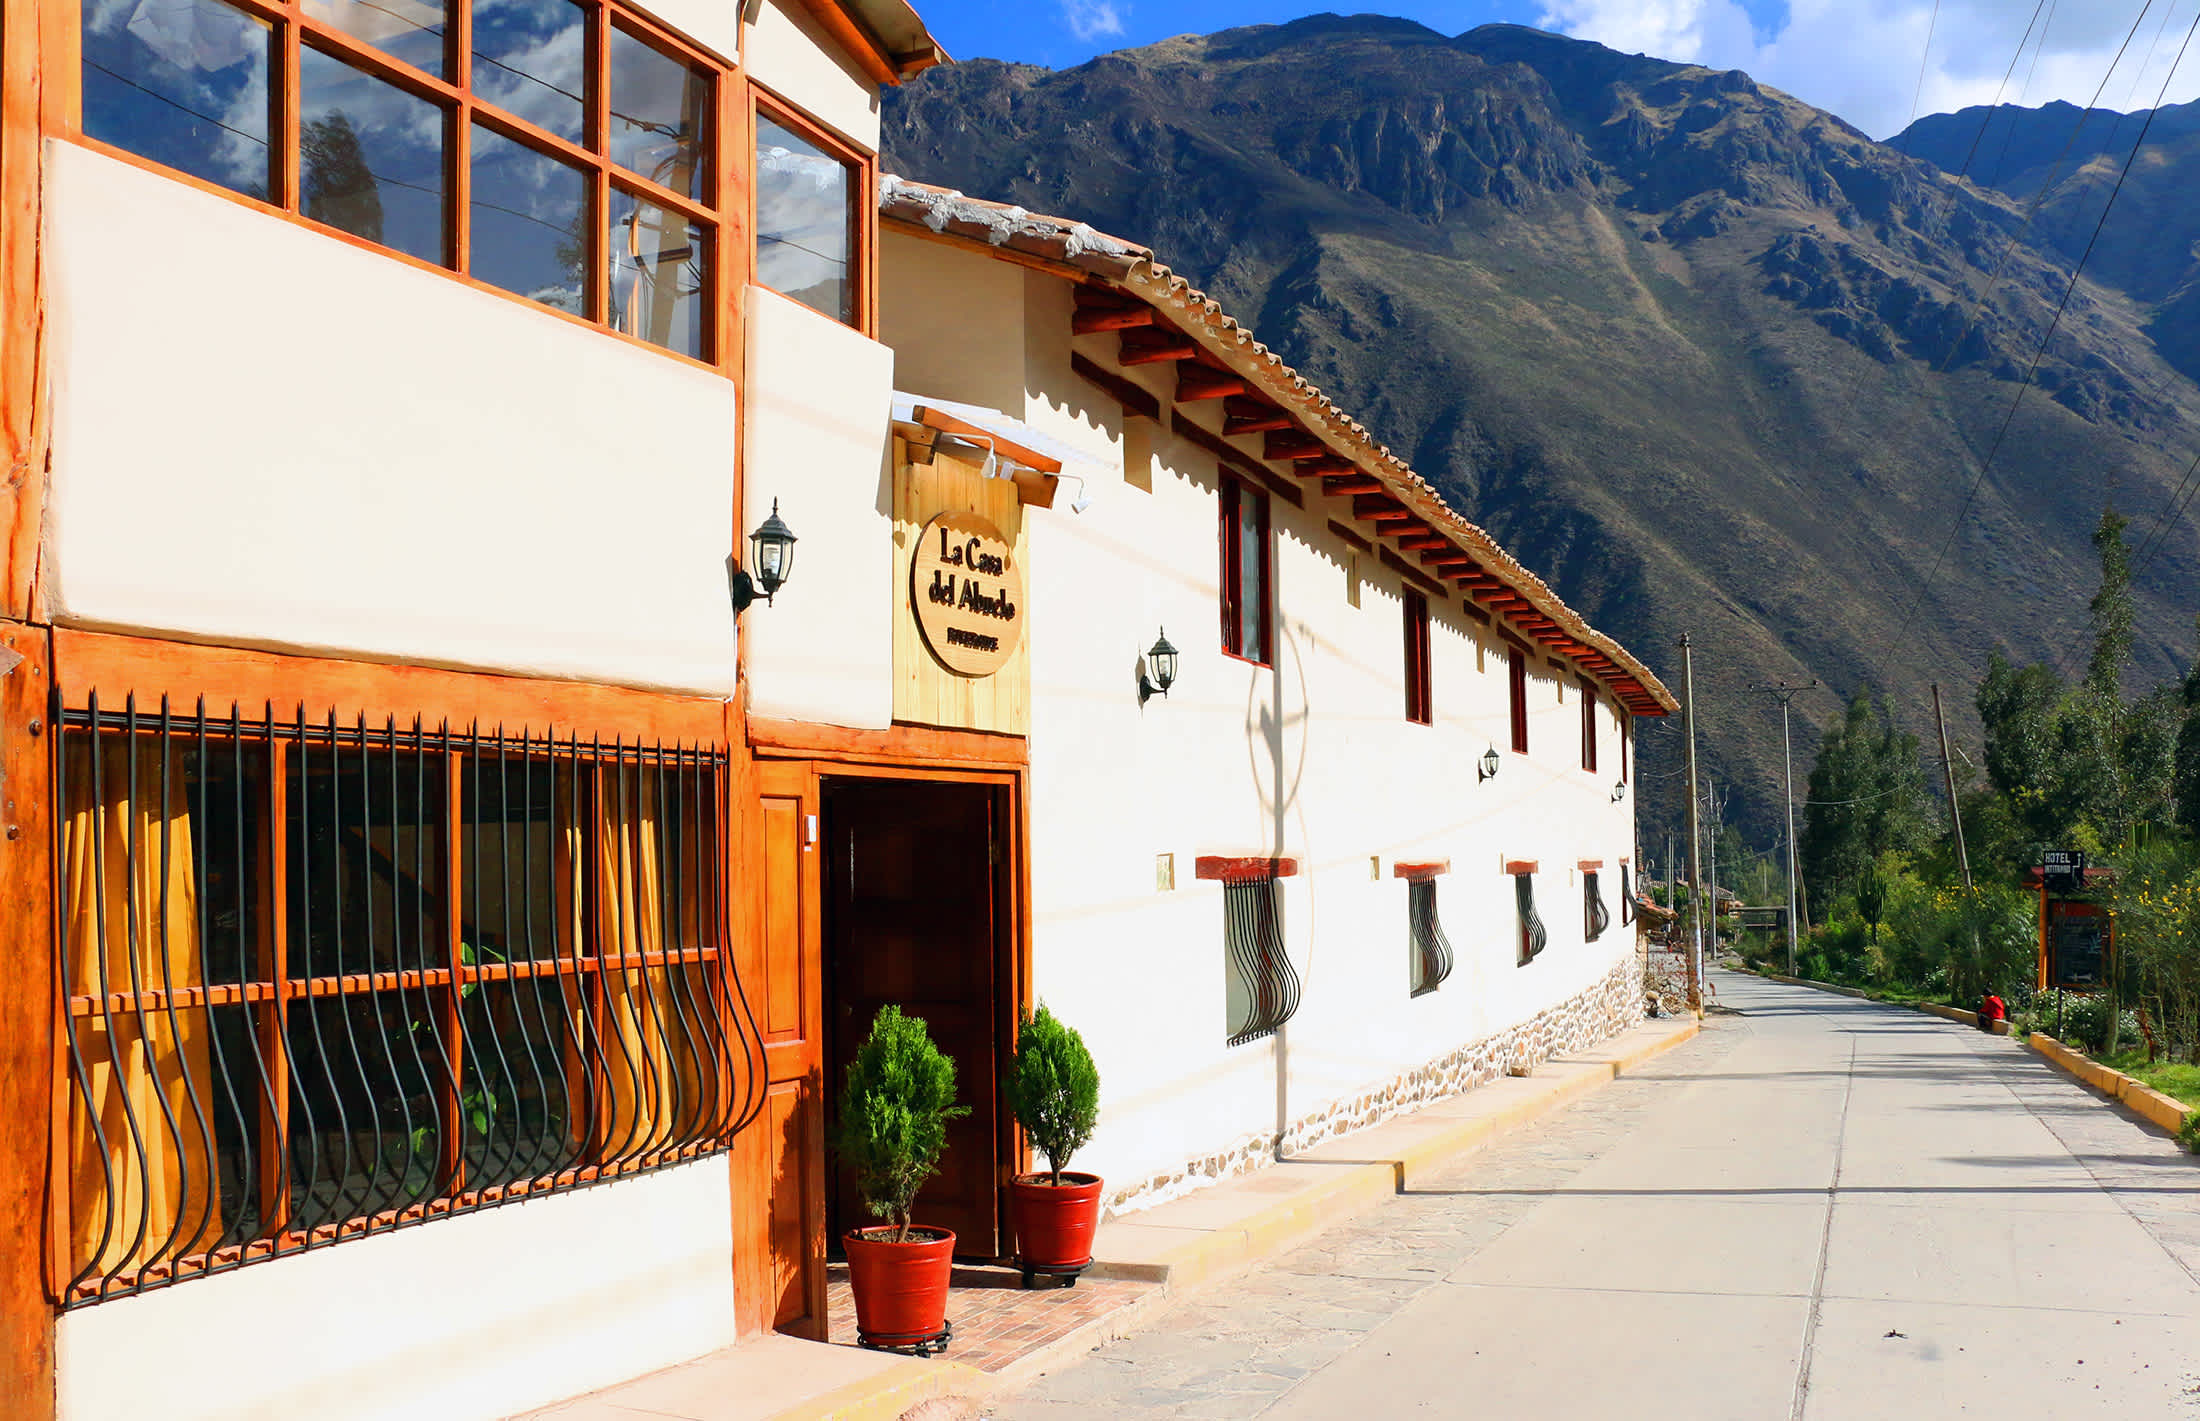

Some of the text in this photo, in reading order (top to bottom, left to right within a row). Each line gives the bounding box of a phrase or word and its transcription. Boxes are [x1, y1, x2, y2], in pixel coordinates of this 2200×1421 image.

[940, 527, 1003, 576] La Casa
[929, 570, 1016, 622] del Abuelo
[2045, 852, 2071, 864] HOTEL
